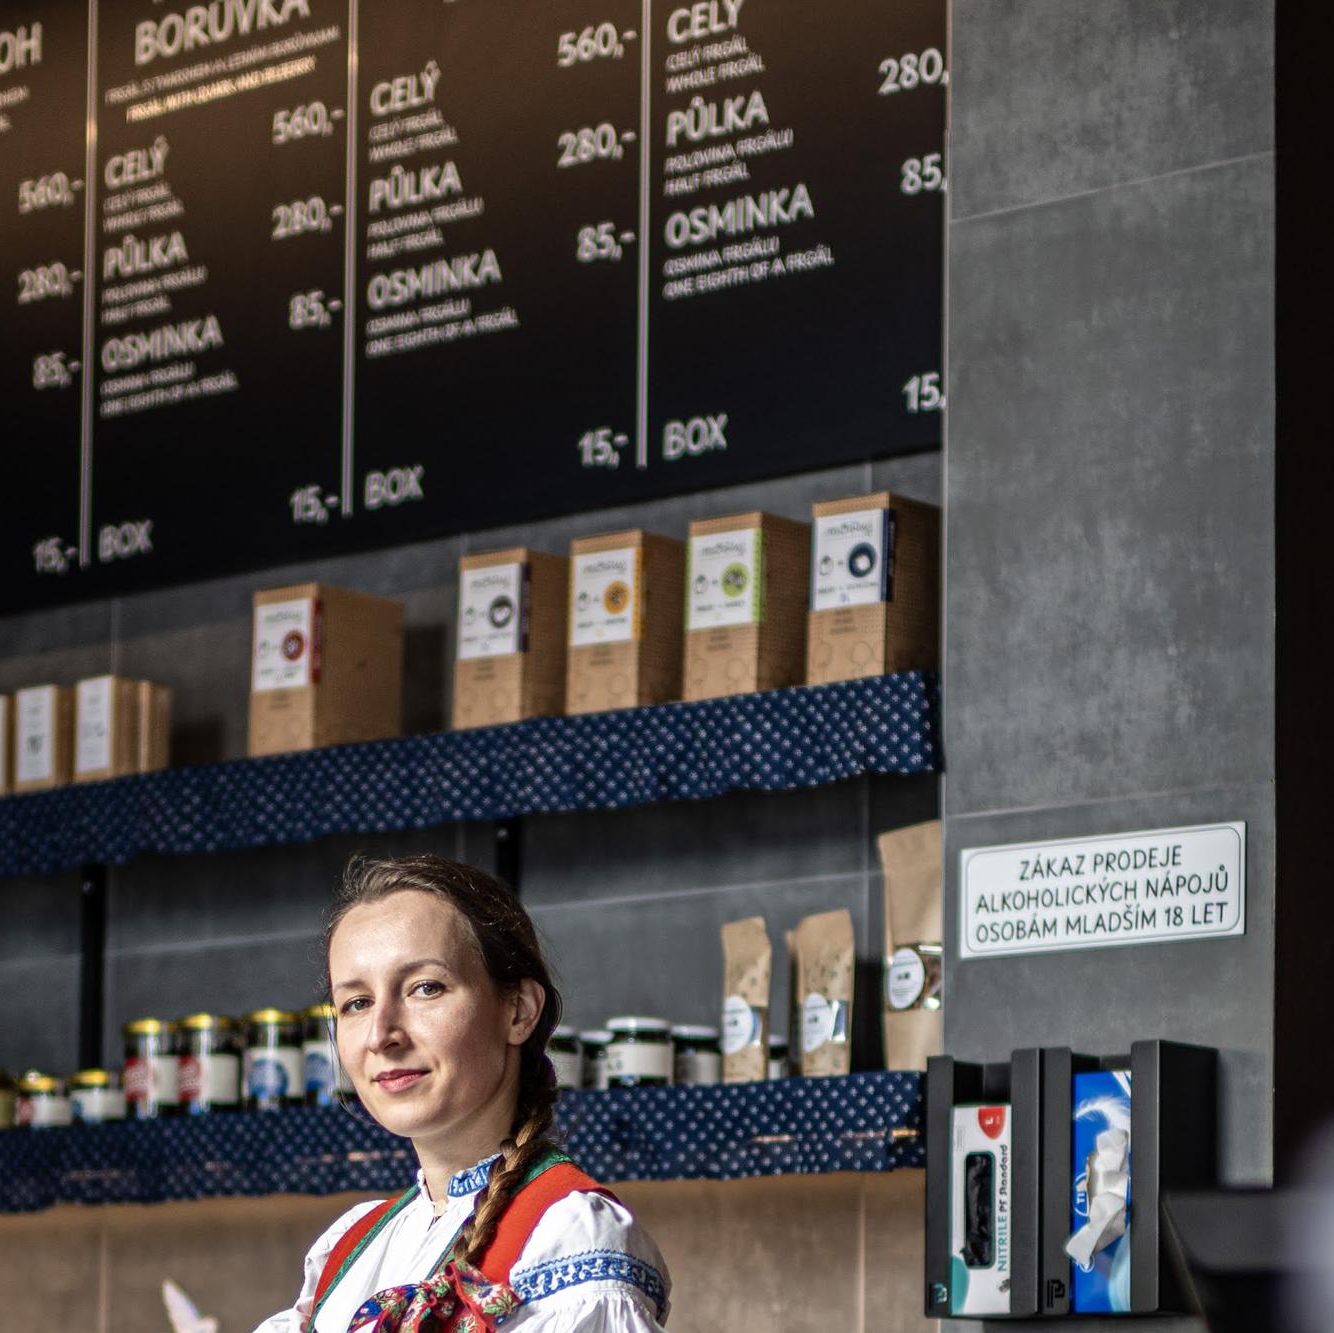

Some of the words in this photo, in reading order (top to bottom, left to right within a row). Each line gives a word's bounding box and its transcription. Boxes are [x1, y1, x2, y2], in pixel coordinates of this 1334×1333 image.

[557, 22, 637, 67] 560,-
[370, 59, 441, 117] CELÝ
[272, 101, 345, 145] 560,-
[667, 90, 769, 147] PŮLKA
[104, 134, 169, 190] CELÝ
[557, 123, 637, 168] 280,-
[369, 160, 463, 214] PŮLKA
[271, 196, 343, 241] 280,-
[666, 183, 815, 247] OSMINKA
[103, 231, 188, 281] PŮLKA
[576, 222, 636, 263] 85,-
[368, 249, 502, 309] OSMINKA
[101, 315, 224, 373] OSMINKA
[578, 427, 629, 467] 15,-
[664, 412, 728, 460] BOX
[365, 465, 424, 509] BOX
[98, 520, 153, 563] BOX
[1019, 853, 1085, 881] ZÁKAZ
[1094, 845, 1182, 873] PRODEJE
[975, 877, 1137, 915] ALKOHOLICKÝCH
[1146, 864, 1228, 899] NÁPOJŮ
[976, 913, 1057, 943] OSOBÁM
[1066, 902, 1156, 936] MLADŠÍM
[1165, 906, 1183, 927] 18
[1192, 902, 1228, 925] LET
[999, 1143, 1009, 1195] Standard
[998, 1214, 1009, 1272] NITRILE
